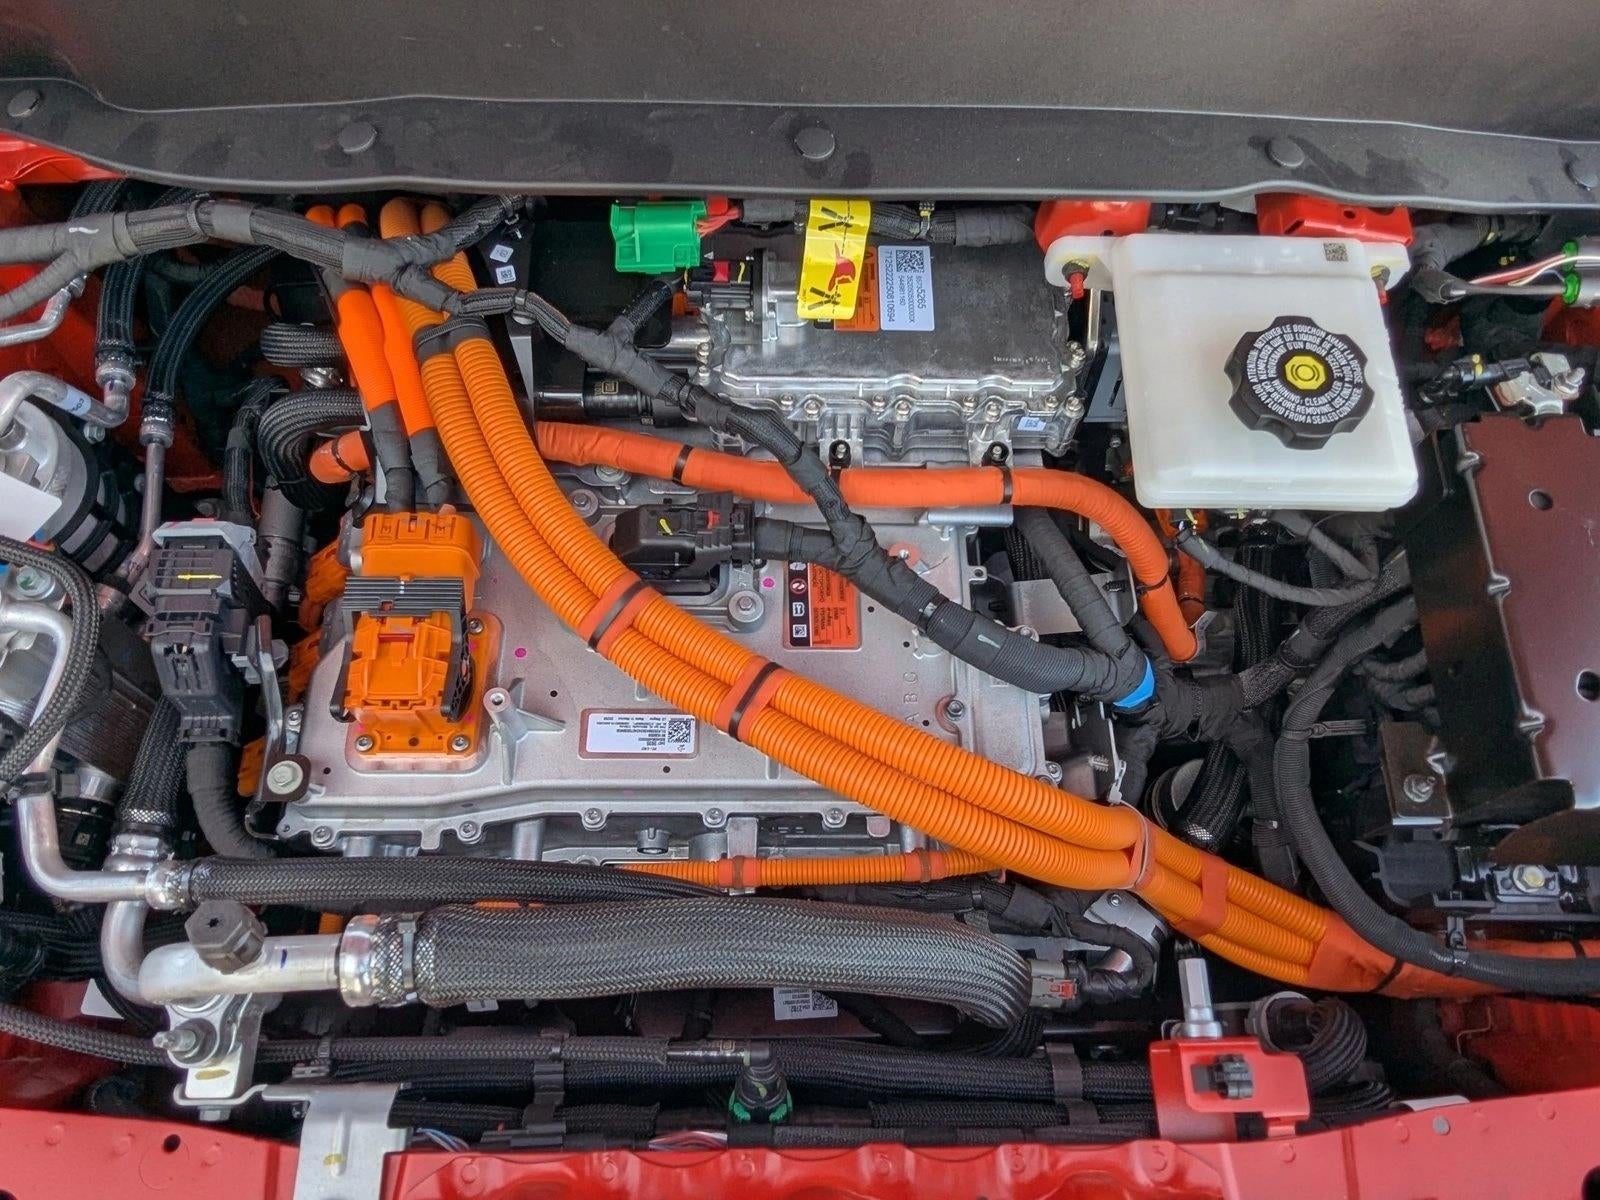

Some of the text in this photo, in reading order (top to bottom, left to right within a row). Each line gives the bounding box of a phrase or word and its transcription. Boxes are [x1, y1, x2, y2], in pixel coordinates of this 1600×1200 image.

[1281, 324, 1292, 333] LE
[1292, 324, 1326, 338] BOUCHON
[1325, 334, 1348, 351] AVANT
[1343, 349, 1354, 361] LA
[1283, 333, 1295, 342] DU
[1295, 332, 1322, 346] LIQUIDE
[1321, 340, 1333, 351] DE
[1330, 347, 1348, 366] FREIN
[1286, 341, 1304, 351] D'UN
[1304, 342, 1328, 357] BIDON
[1261, 380, 1275, 393] CAP
[1270, 391, 1297, 412] BEFORE
[1331, 395, 1346, 409] USE
[1304, 395, 1329, 406] CLEAN
[1324, 380, 1343, 402] FILLER
[1263, 397, 1286, 416] FLUID
[1284, 409, 1306, 423] FROM
[1306, 415, 1312, 424] A
[1311, 411, 1339, 425] SEALED
